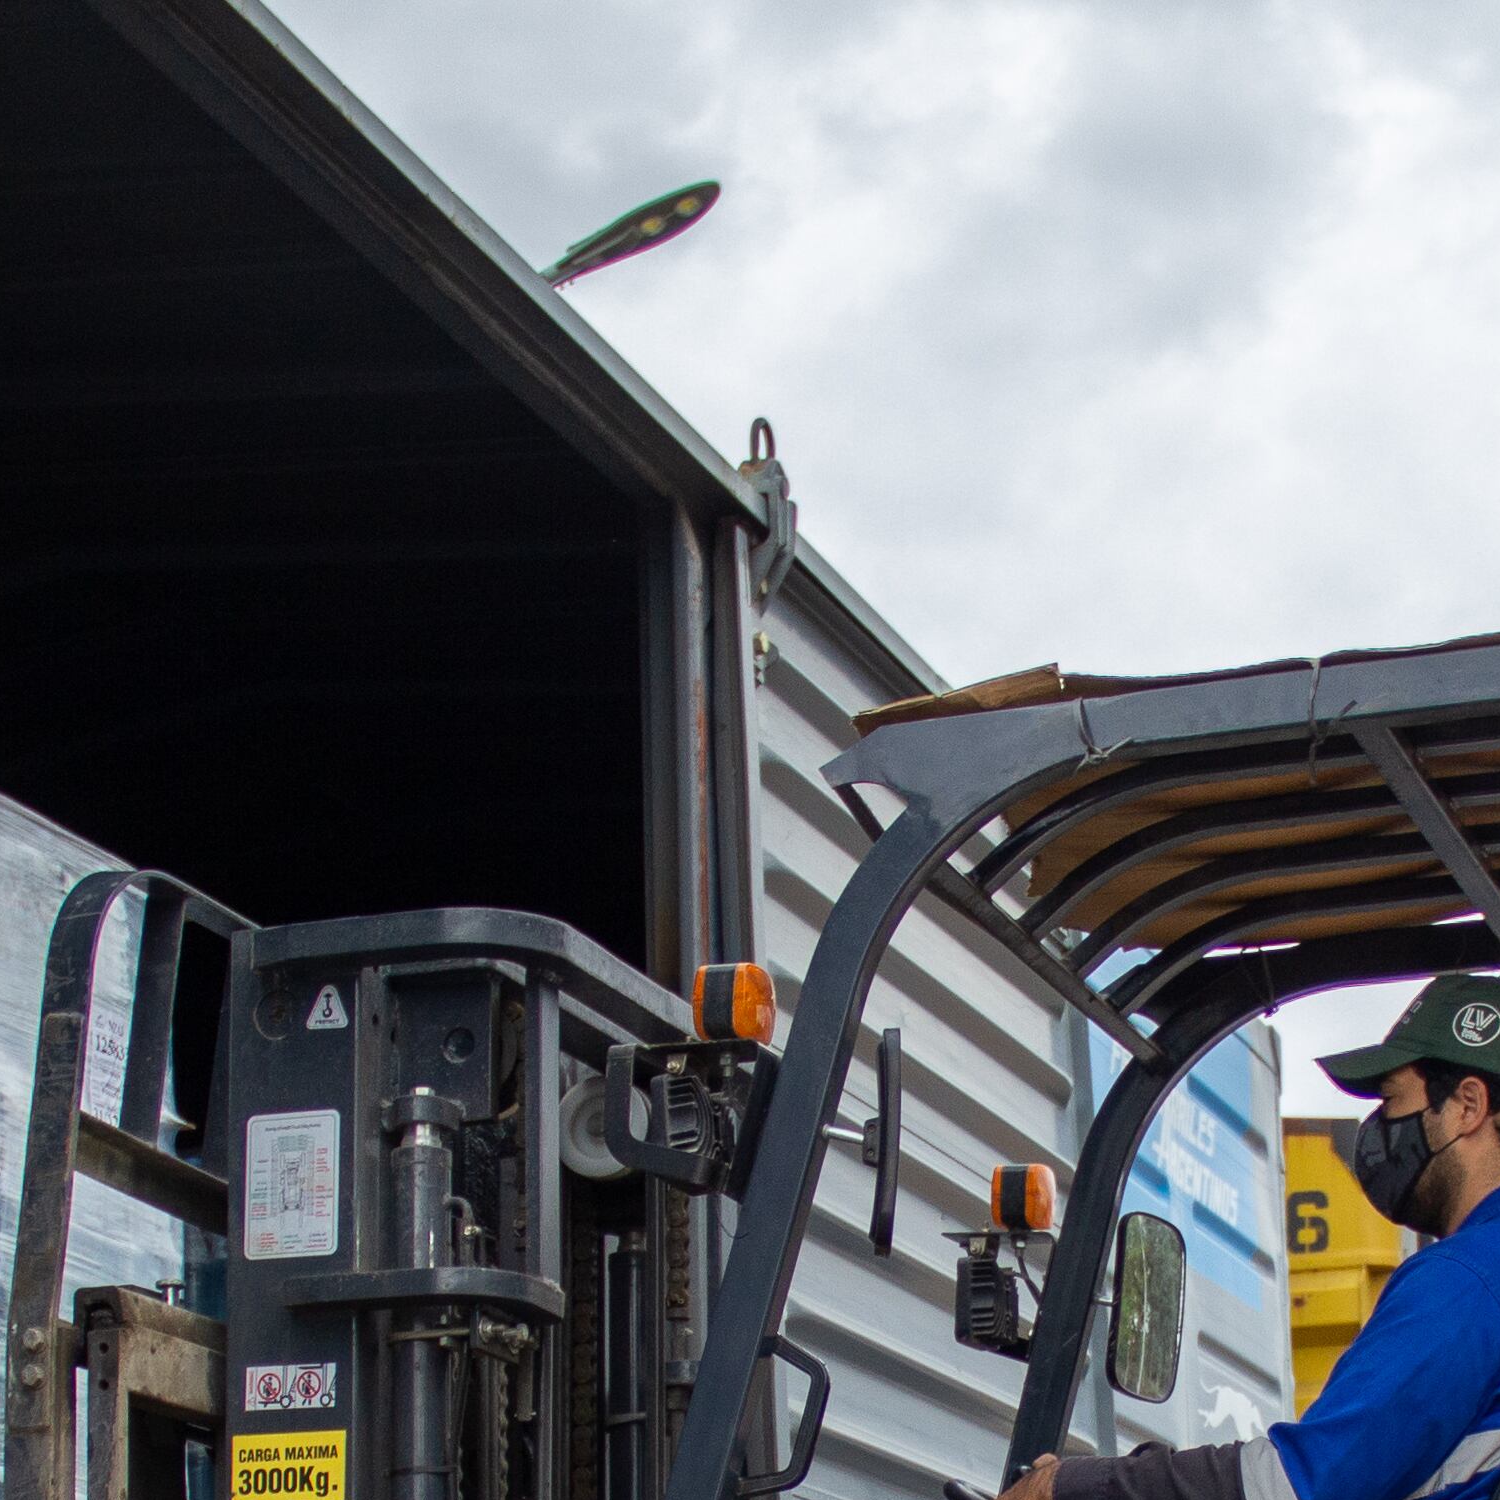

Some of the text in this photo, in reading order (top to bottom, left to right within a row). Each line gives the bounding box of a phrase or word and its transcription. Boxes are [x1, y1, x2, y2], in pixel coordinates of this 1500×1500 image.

[1461, 1006, 1498, 1031] LV
[238, 1445, 338, 1463] CARGA MAXIMA
[238, 1466, 338, 1497] 3000Kg.
